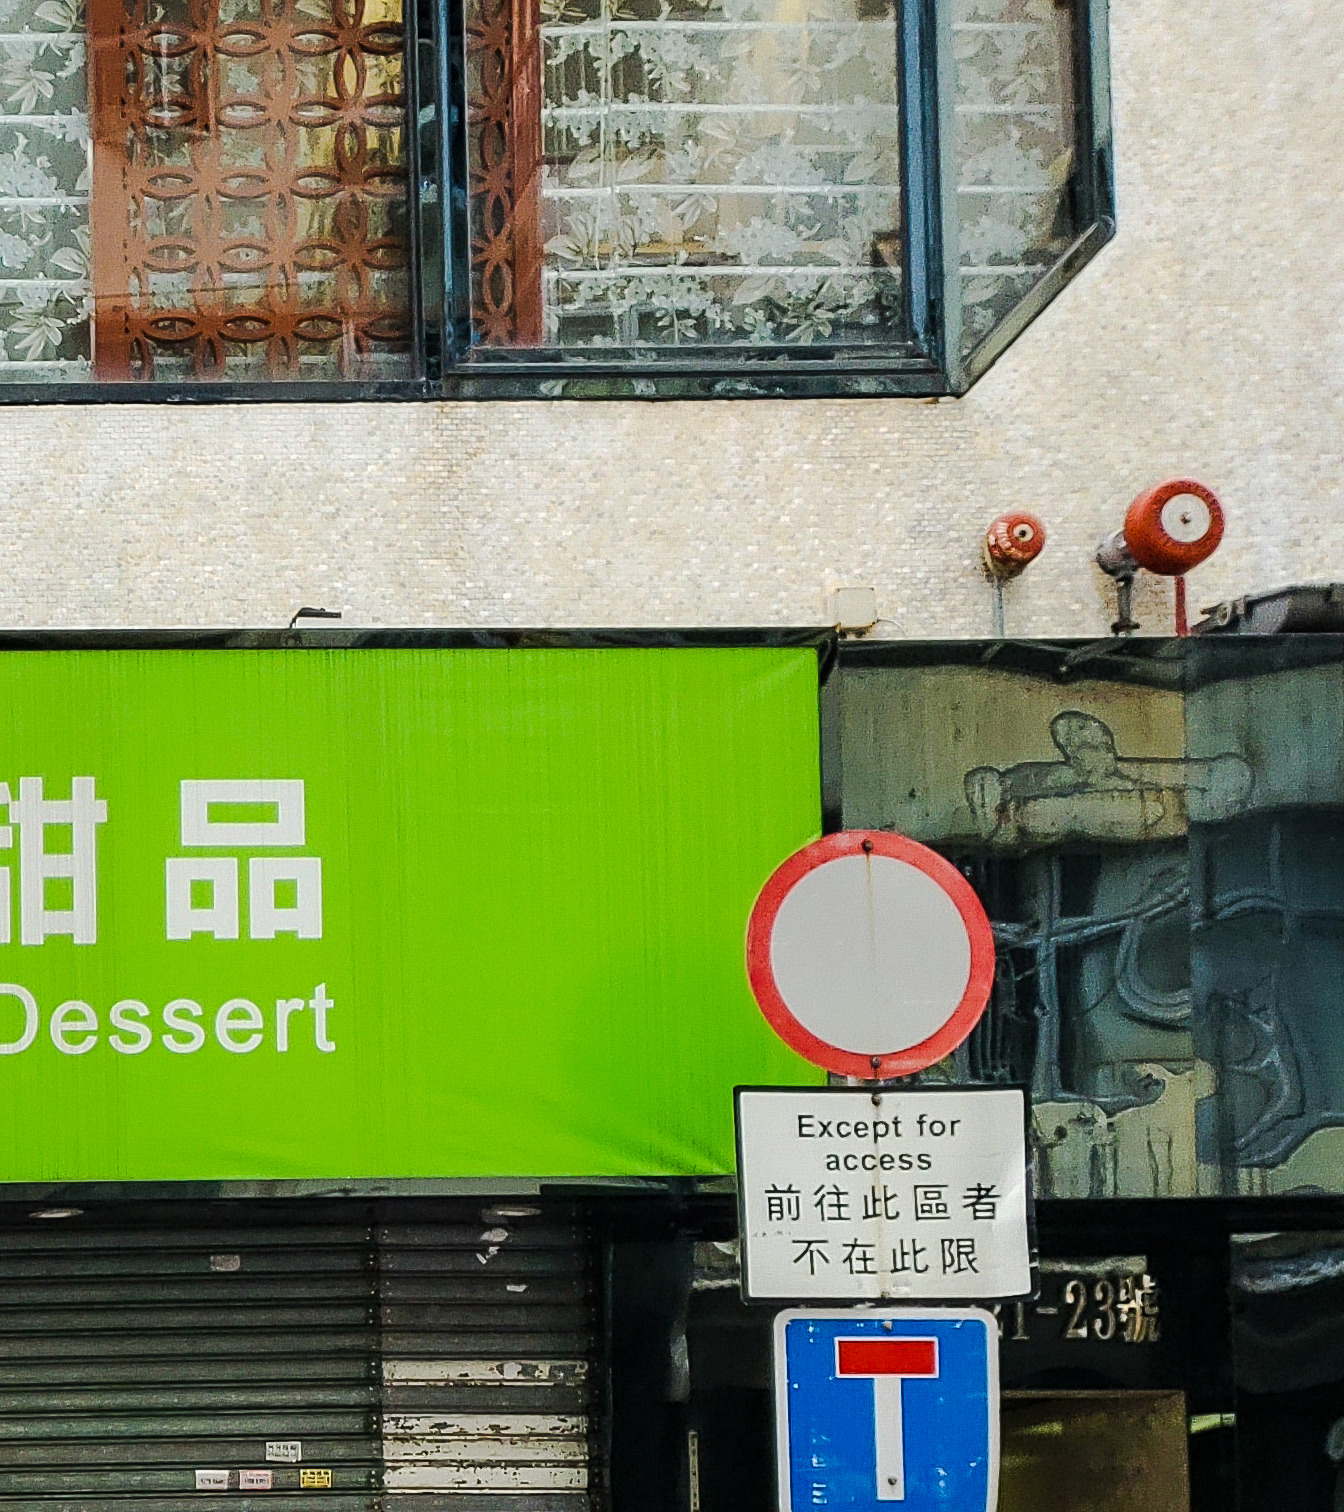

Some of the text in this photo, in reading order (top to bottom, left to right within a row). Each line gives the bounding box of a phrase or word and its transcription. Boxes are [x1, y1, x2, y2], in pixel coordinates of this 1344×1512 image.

[796, 1113, 962, 1143] Except for
[825, 1151, 933, 1172] access
[764, 1182, 1002, 1222] 前往此區者
[791, 1237, 981, 1276] 不在此限
